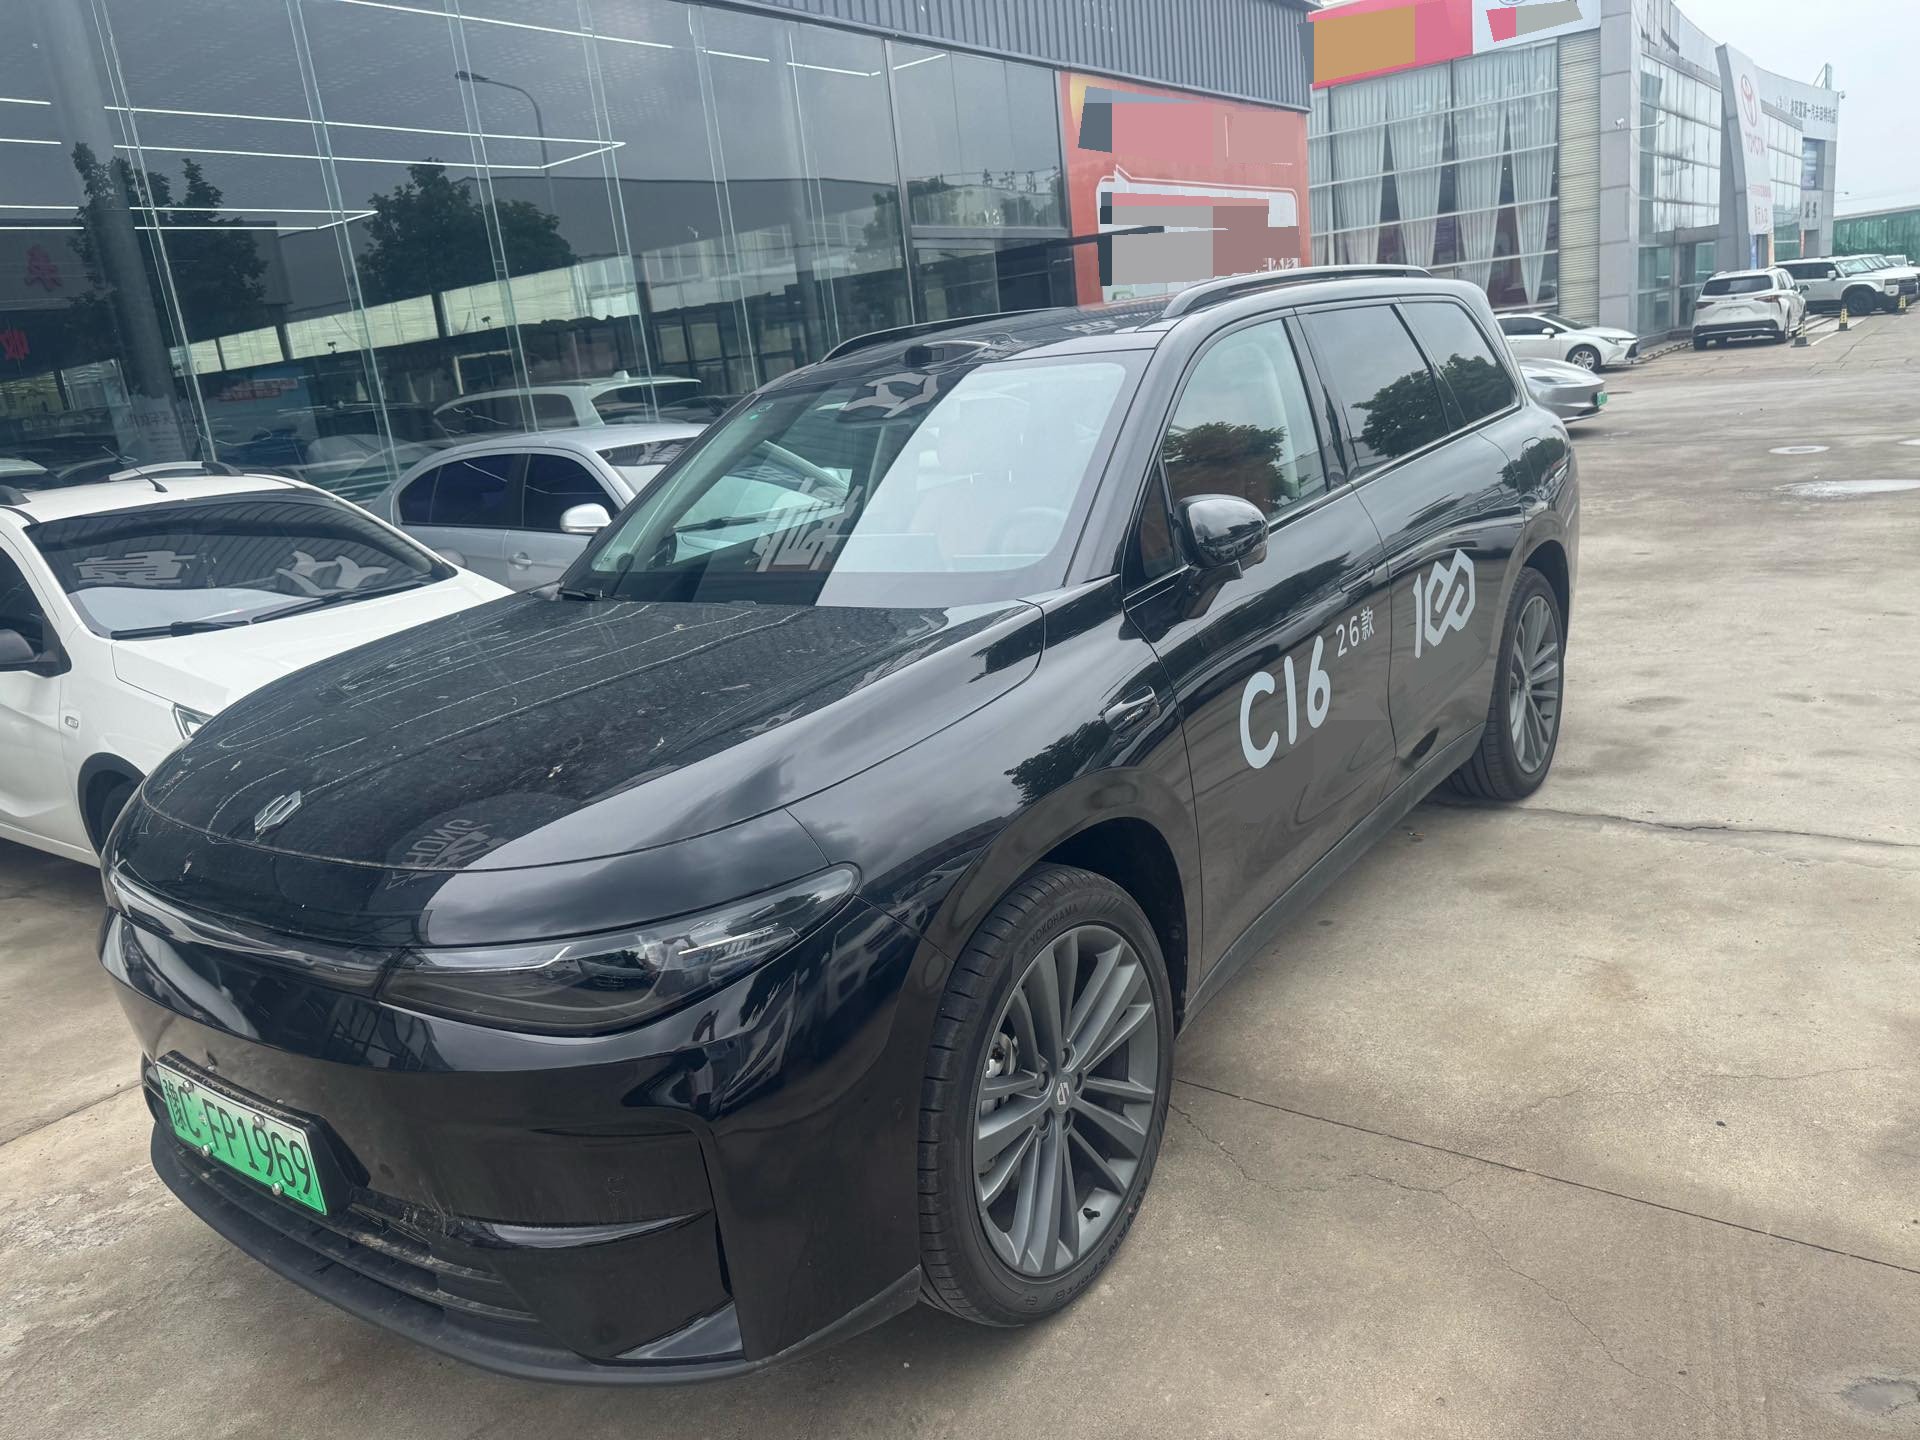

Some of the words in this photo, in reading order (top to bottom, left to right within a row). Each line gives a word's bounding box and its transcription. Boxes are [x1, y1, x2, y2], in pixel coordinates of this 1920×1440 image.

[1335, 606, 1375, 657] 26款
[1240, 635, 1331, 769] C16
[1029, 903, 1080, 946] YOKOHAMA
